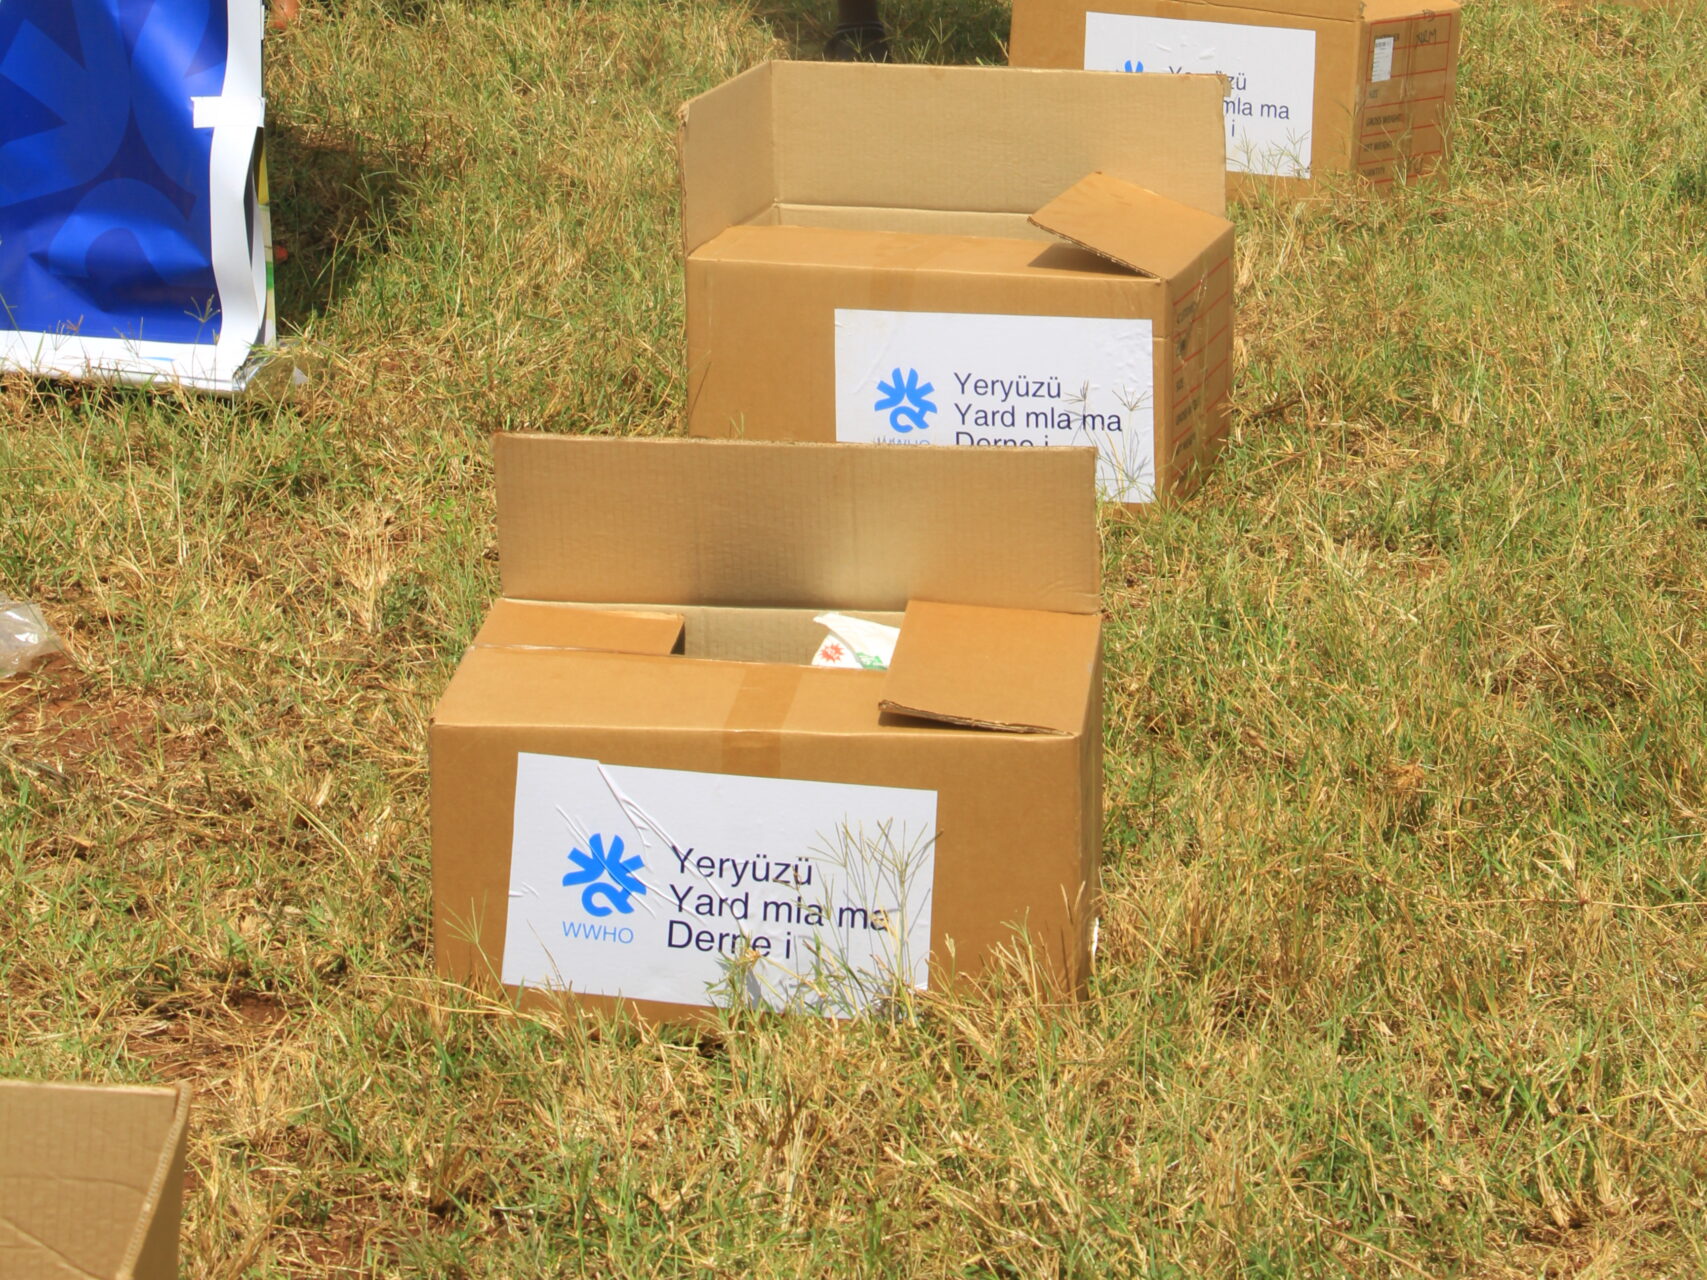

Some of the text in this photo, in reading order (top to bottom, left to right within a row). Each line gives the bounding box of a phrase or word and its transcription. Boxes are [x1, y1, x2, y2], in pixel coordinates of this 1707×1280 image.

[1260, 103, 1290, 120] ma
[954, 372, 1061, 403] Yeryüzü
[954, 403, 1123, 432] Yard mla ma
[671, 845, 813, 888] Yeryüzü
[669, 884, 750, 920] Yard
[762, 896, 825, 927] mla
[562, 920, 635, 945] WWHO
[667, 920, 772, 958] Derne
